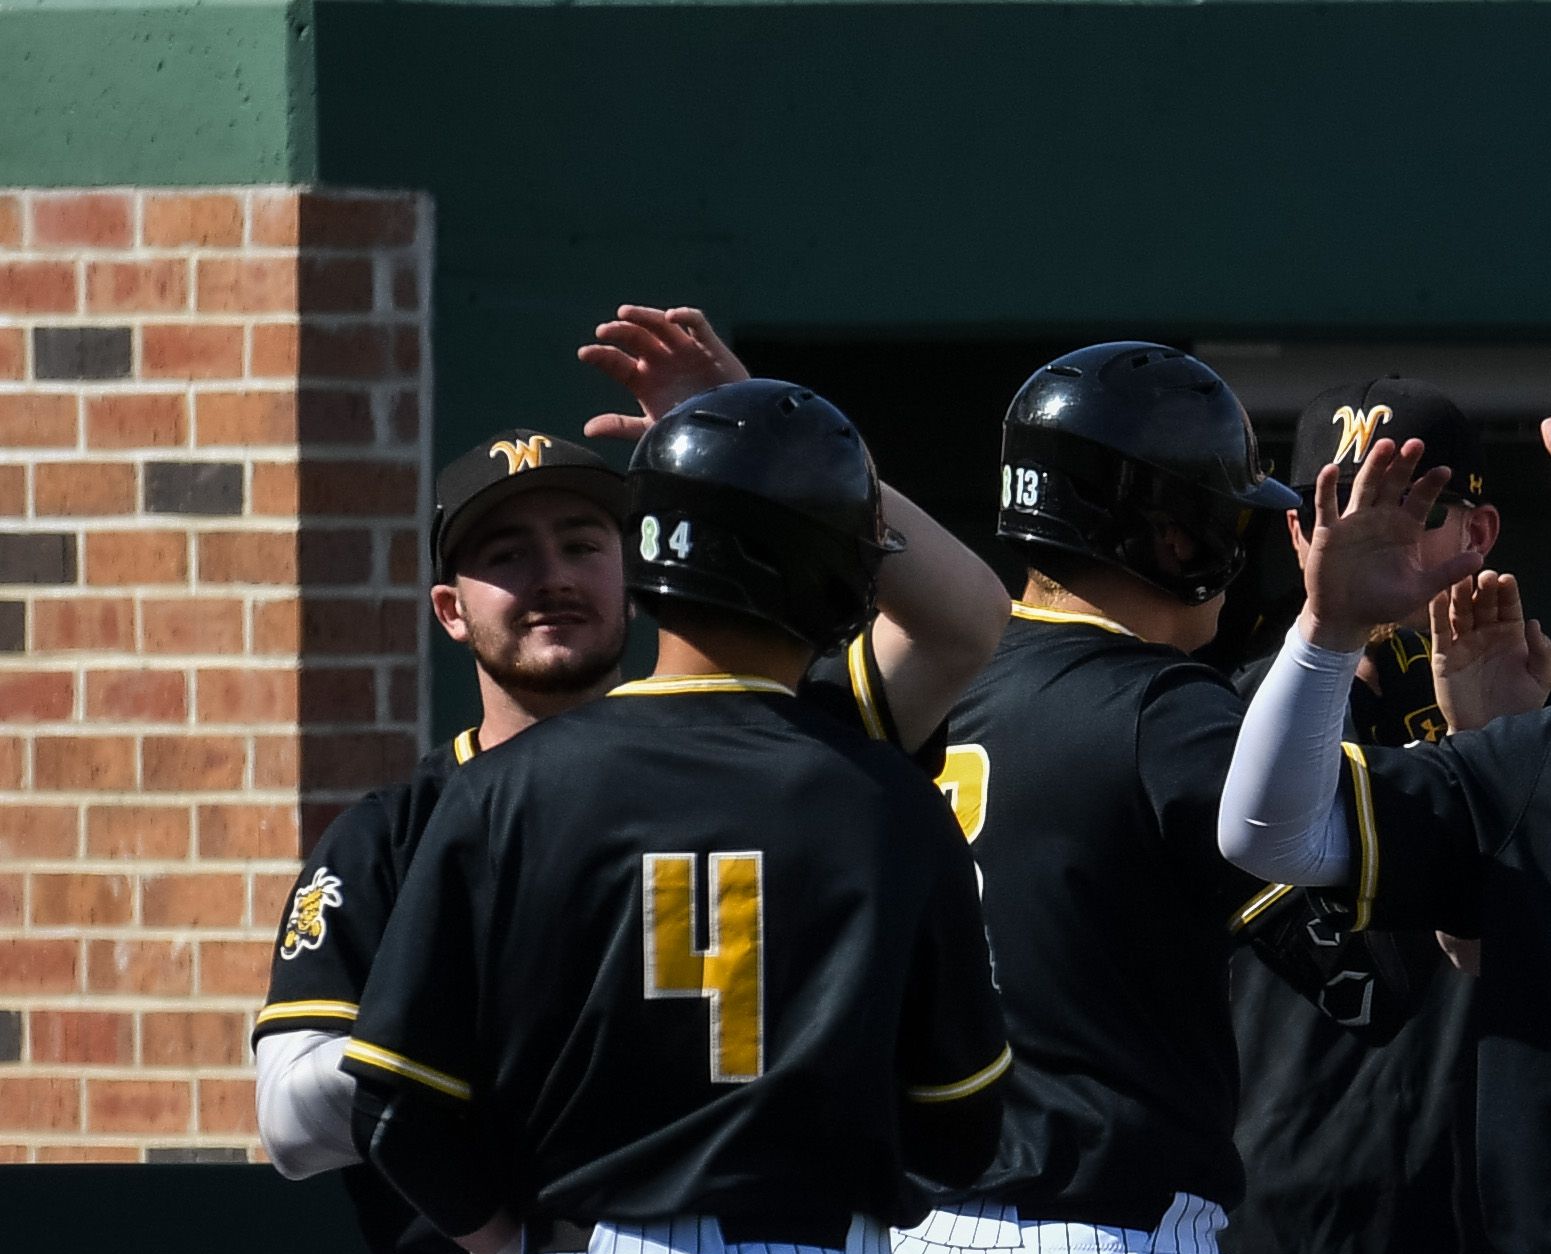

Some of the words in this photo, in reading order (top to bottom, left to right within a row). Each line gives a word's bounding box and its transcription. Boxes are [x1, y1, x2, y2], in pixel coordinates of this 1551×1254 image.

[490, 435, 552, 475] W
[1332, 404, 1393, 464] W
[1015, 467, 1039, 507] 13
[642, 850, 764, 1084] 4
